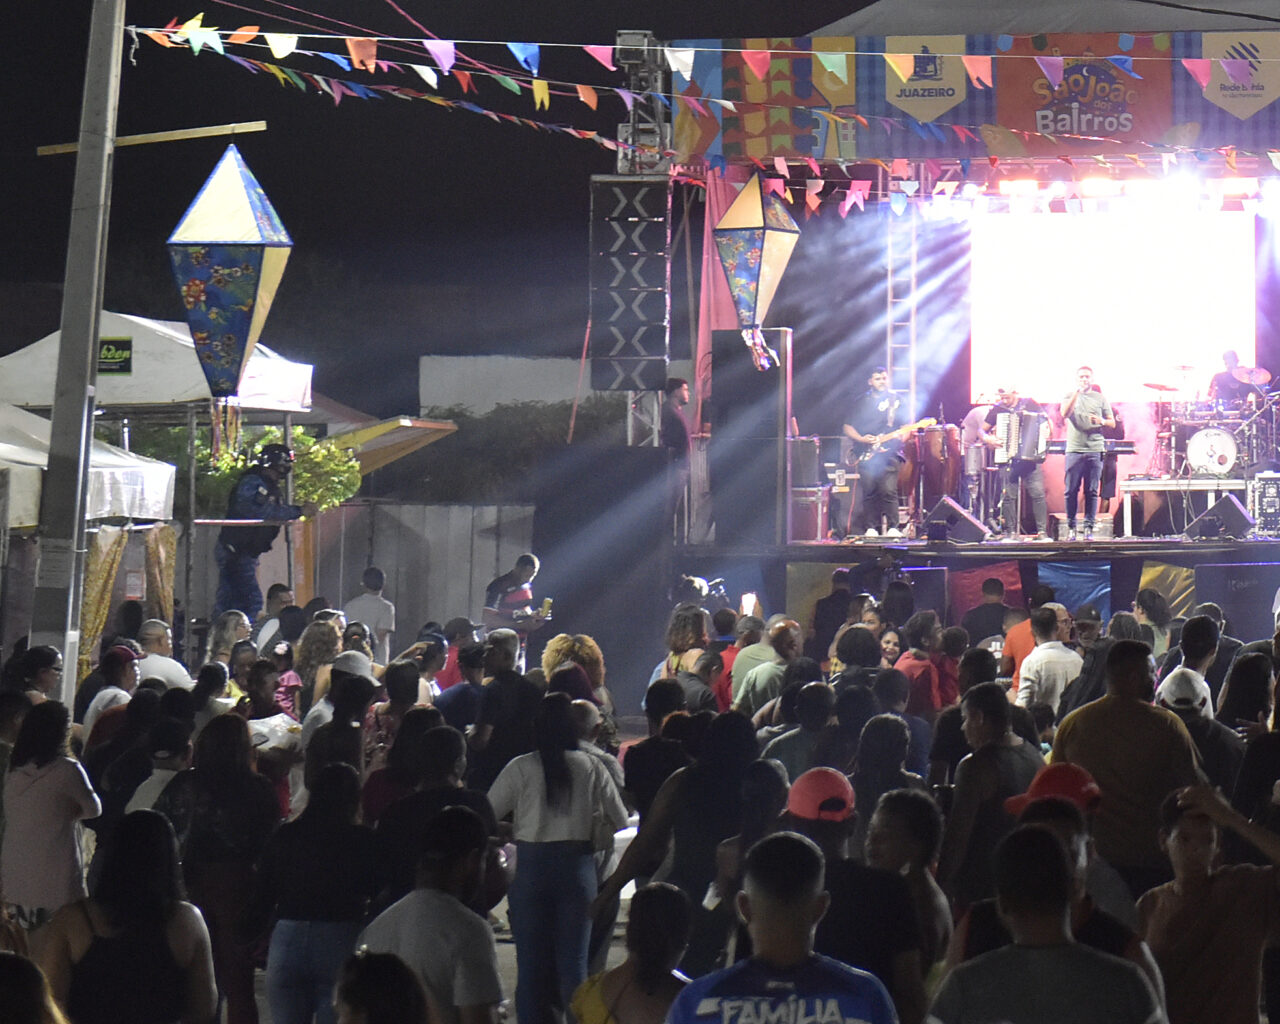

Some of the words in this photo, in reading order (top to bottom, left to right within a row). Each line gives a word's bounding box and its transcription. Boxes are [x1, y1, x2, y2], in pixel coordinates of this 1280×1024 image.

[896, 88, 955, 98] JUAZEIRO
[1242, 82, 1264, 91] bhia
[1036, 102, 1133, 134] Bairros
[722, 994, 844, 1024] FAMÍLIA
